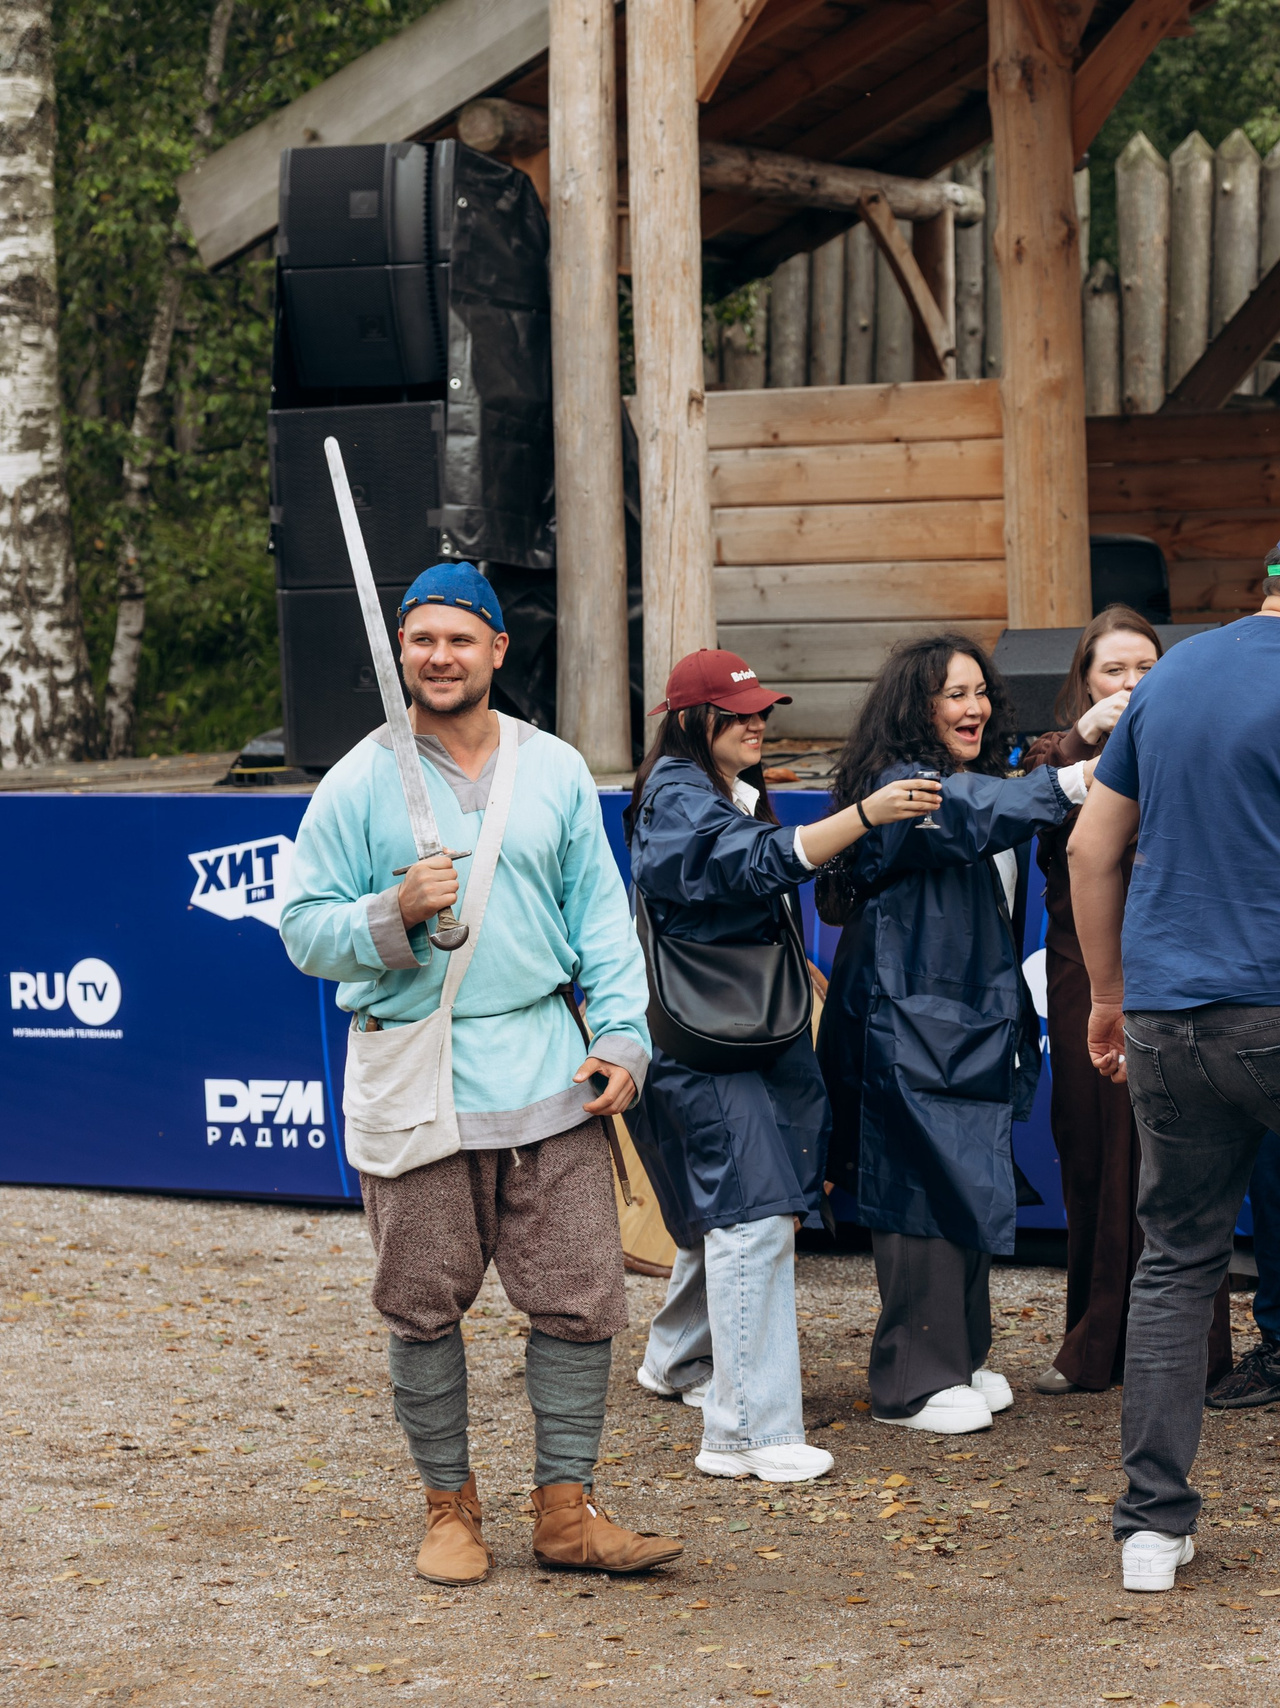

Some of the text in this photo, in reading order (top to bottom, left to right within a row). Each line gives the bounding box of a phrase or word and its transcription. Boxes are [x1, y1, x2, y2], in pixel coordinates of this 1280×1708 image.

[199, 843, 279, 895] ХИТ
[251, 887, 267, 901] FM
[10, 971, 108, 1010] RU TV
[12, 1027, 123, 1040] МУЗЫКАЛЬНЫЙ ТЕЛЕКАНАЛ
[204, 1078, 325, 1125] DFM
[207, 1126, 326, 1149] РАДИО
